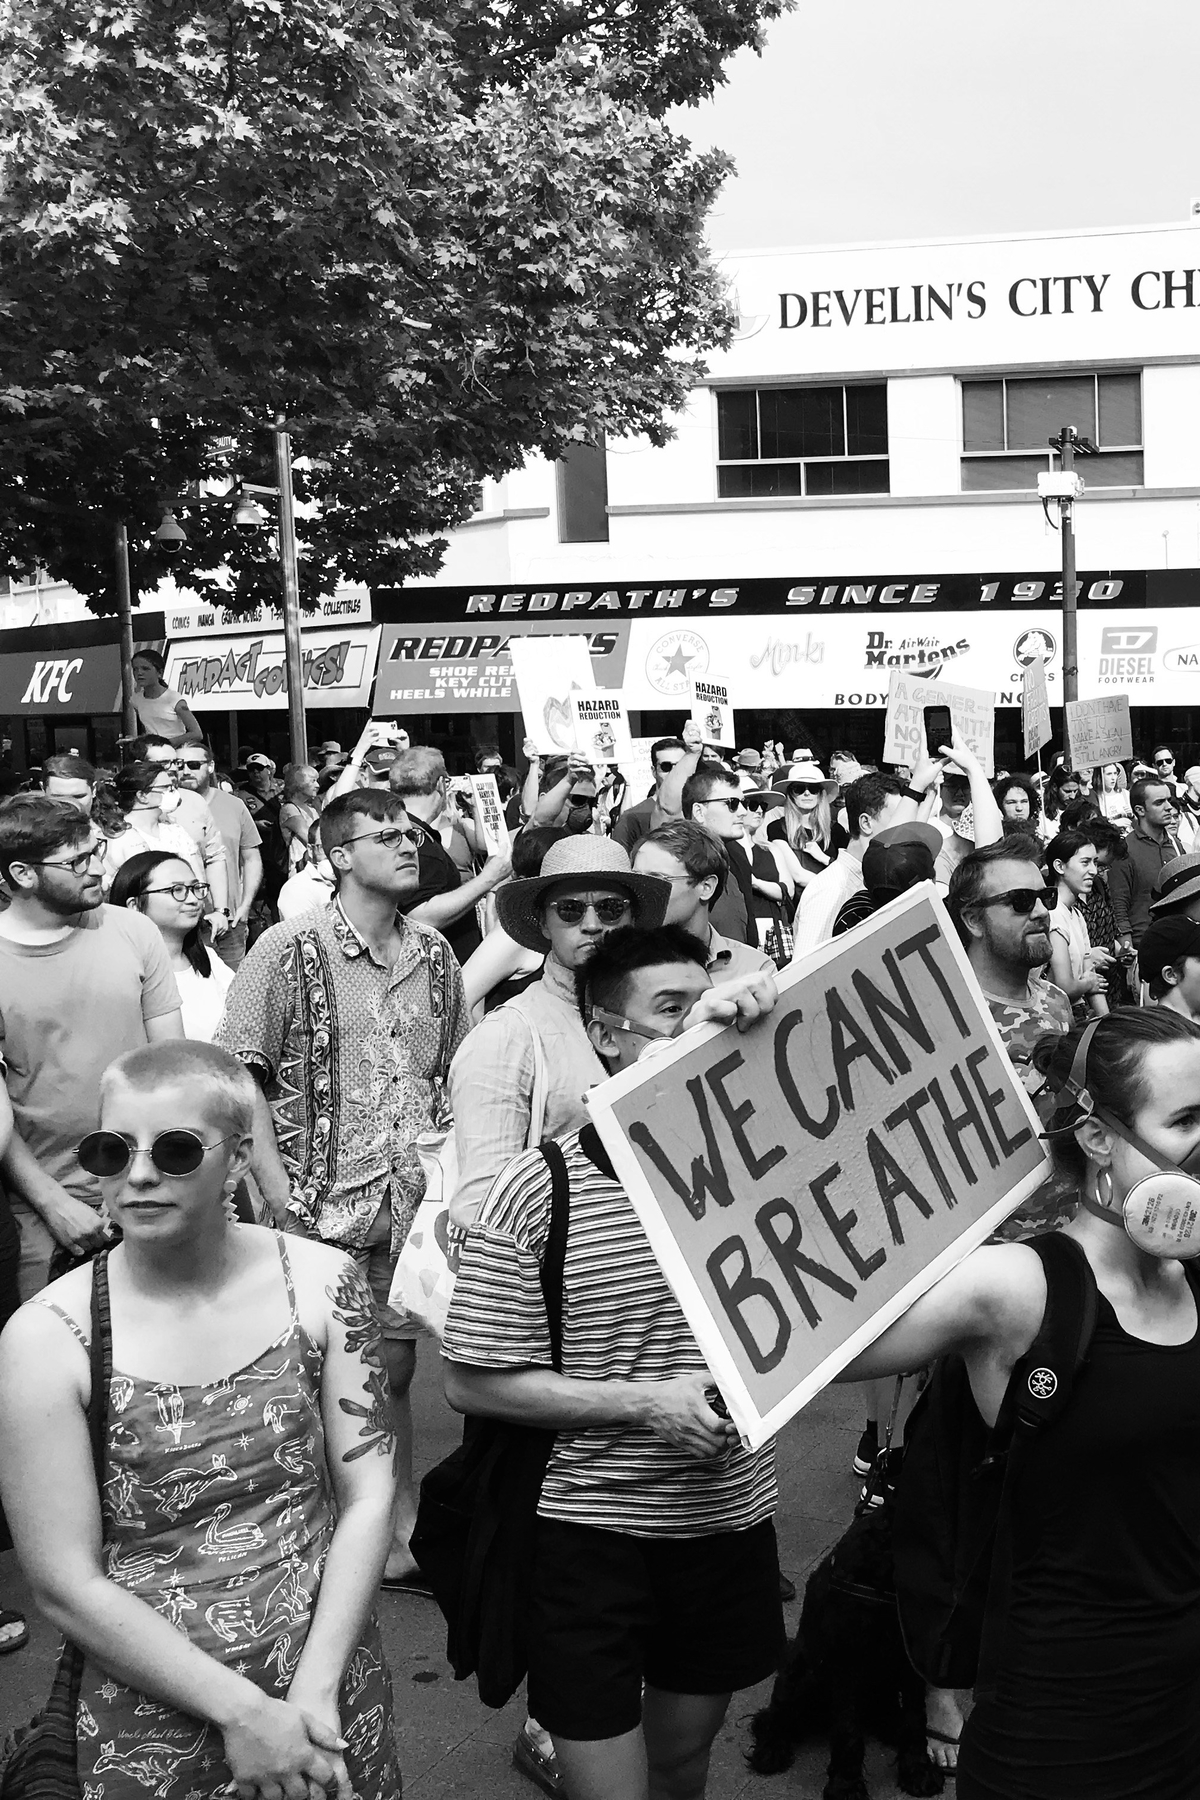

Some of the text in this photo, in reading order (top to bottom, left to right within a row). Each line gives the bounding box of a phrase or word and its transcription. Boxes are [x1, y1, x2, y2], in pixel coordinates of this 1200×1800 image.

[778, 280, 986, 329] DEVELIN'S
[1008, 273, 1111, 318] CITY
[465, 587, 740, 614] REDPATH'S
[785, 583, 941, 607] SINCE
[172, 615, 190, 630] COMICS
[197, 613, 215, 628] MANGA
[323, 599, 362, 617] COLLECTIBLES
[656, 634, 704, 653] CONVERSE
[866, 631, 893, 649] Dr.
[864, 638, 971, 669] Martens
[429, 666, 478, 677] SHOE
[1099, 656, 1156, 676] DIESEL
[20, 658, 84, 703] KFC
[435, 677, 473, 688] KEY
[695, 681, 728, 697] HAZARD
[1098, 676, 1156, 685] FOOTWEAR
[390, 687, 512, 700] HEELS WHILE
[695, 692, 729, 706] REDUCTION
[577, 699, 620, 712] HAZARD
[579, 711, 622, 721] REDUCTION
[627, 923, 972, 1222] WE CANT
[705, 1045, 1033, 1375] BREATHE
